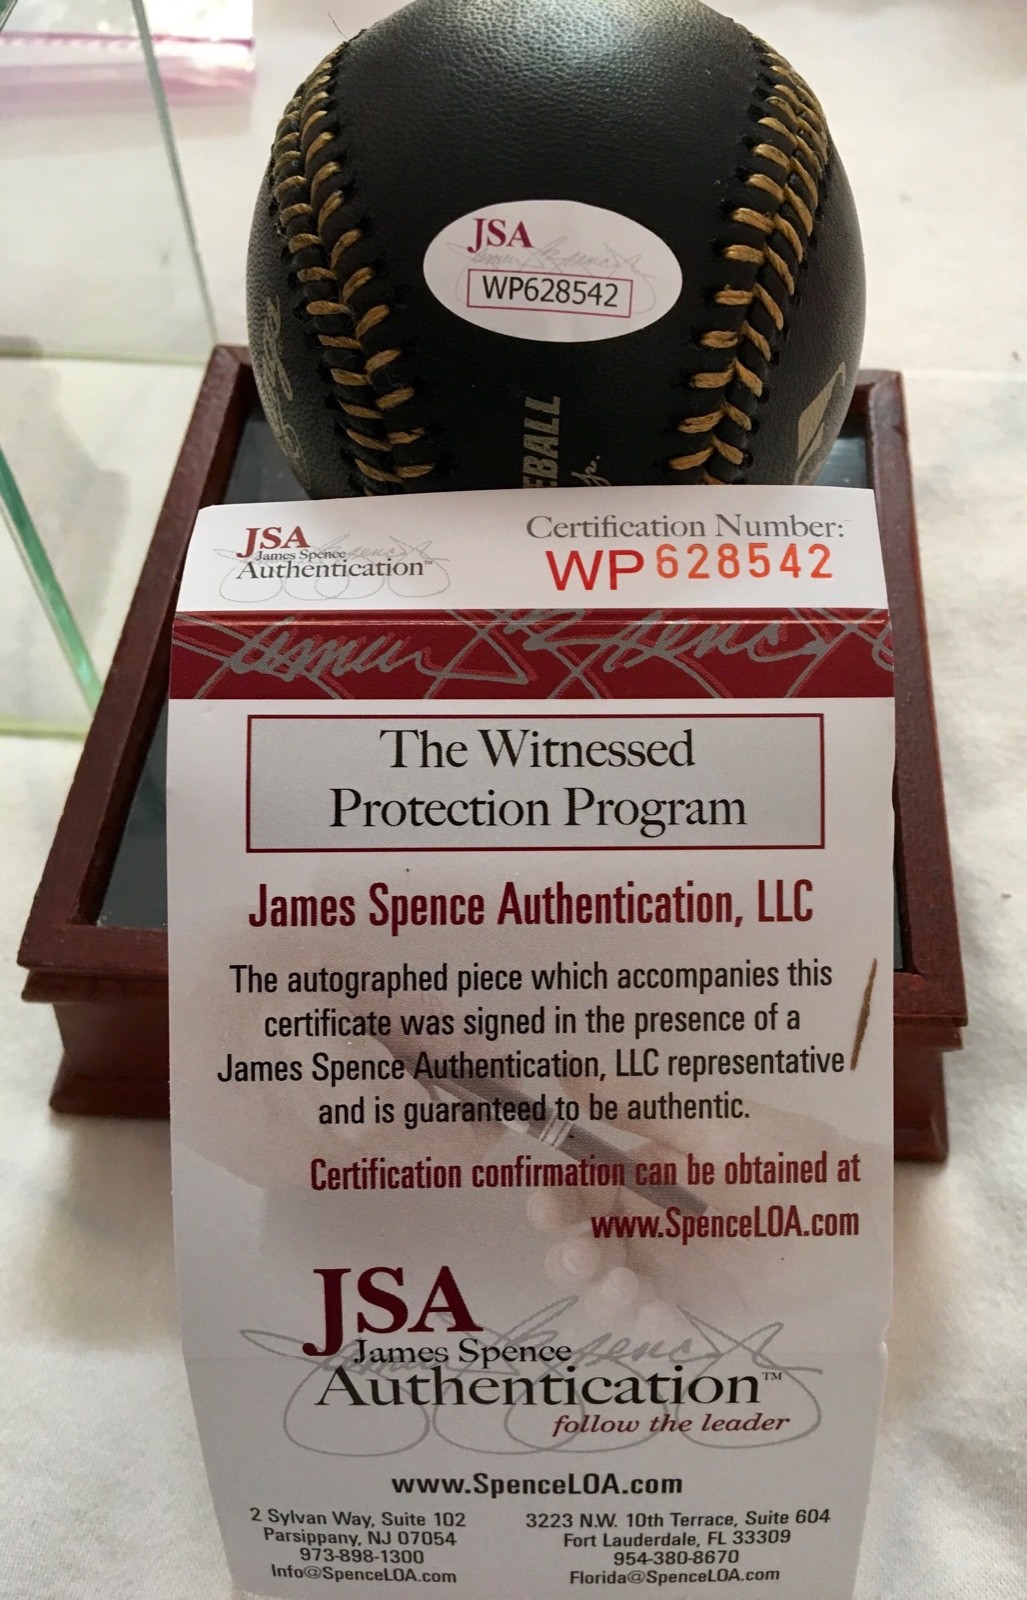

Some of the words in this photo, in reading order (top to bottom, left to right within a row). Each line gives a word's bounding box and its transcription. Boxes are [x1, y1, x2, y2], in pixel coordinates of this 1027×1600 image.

[467, 218, 534, 253] JSA
[482, 275, 619, 308] WP628542
[526, 514, 705, 539] Certification
[715, 513, 845, 539] Number:
[236, 526, 311, 559] JSA
[256, 550, 296, 562] James
[299, 549, 346, 561] Spence
[379, 728, 468, 769] The
[477, 728, 696, 769] Witnessed
[329, 787, 551, 829] Protection
[563, 786, 747, 838] Program
[248, 883, 356, 929] James
[368, 882, 485, 936] Spence
[498, 881, 745, 928] Authentication,
[757, 879, 814, 923] LLC
[229, 965, 279, 993] The
[287, 961, 449, 997] autographed
[457, 963, 522, 996] piece
[531, 960, 609, 991] which
[617, 959, 781, 994] accompanies
[786, 957, 833, 987] this
[264, 1009, 392, 1037] certificate
[401, 1013, 454, 1036] was
[464, 1007, 545, 1042] signed
[554, 1008, 576, 1034] in
[585, 1006, 625, 1034] the
[635, 1008, 746, 1038] presence
[753, 1004, 778, 1032] of
[786, 1011, 801, 1031] a
[218, 1053, 303, 1083] James
[311, 1052, 405, 1085] Spence
[413, 1051, 607, 1082] Authentication,
[615, 1050, 659, 1077] LLC
[668, 1047, 846, 1082] representative
[319, 1098, 365, 1125] and
[374, 1098, 396, 1124] is
[404, 1096, 546, 1130] guaranteed
[555, 1099, 580, 1121] to
[589, 1095, 619, 1121] be
[627, 1093, 750, 1120] authentic.
[310, 1157, 462, 1191] Certification
[471, 1155, 626, 1189] confirmation
[634, 1160, 677, 1186] can
[687, 1154, 716, 1186] be
[724, 1152, 828, 1185] obtained
[837, 1152, 861, 1183] at
[591, 1205, 860, 1244] www.SpenceLOA.com
[302, 1265, 483, 1357] JSA
[353, 1339, 450, 1364] James
[458, 1338, 572, 1368] Spence
[552, 1415, 641, 1438] follow
[650, 1415, 695, 1433] the
[702, 1413, 791, 1432] leader
[392, 1473, 682, 1498] www.SpenceLOA.com
[250, 1508, 262, 1521] 2
[268, 1508, 327, 1526] Sylvan
[332, 1511, 375, 1529] Way,
[381, 1512, 426, 1527] Suite
[434, 1512, 466, 1527] 102
[525, 1513, 573, 1528] 3223
[580, 1514, 618, 1528] N.W.
[627, 1513, 664, 1528] 10th
[669, 1512, 738, 1528] Terrace,
[745, 1511, 789, 1526] Suite
[795, 1509, 830, 1524] 604
[263, 1527, 362, 1546] Parsippany,
[367, 1531, 391, 1545] NJ
[398, 1531, 457, 1546] 07054
[563, 1532, 597, 1547] Fort
[603, 1531, 701, 1548] Lauderdale,
[707, 1531, 727, 1545] FL
[732, 1529, 791, 1545] 33309
[300, 1548, 424, 1564] 973-898-1300
[613, 1550, 739, 1566] 954-380-8670
[271, 1564, 457, 1583] Info@SpenceLOA.com
[570, 1569, 780, 1586] Florida@SpenceLOA.com
